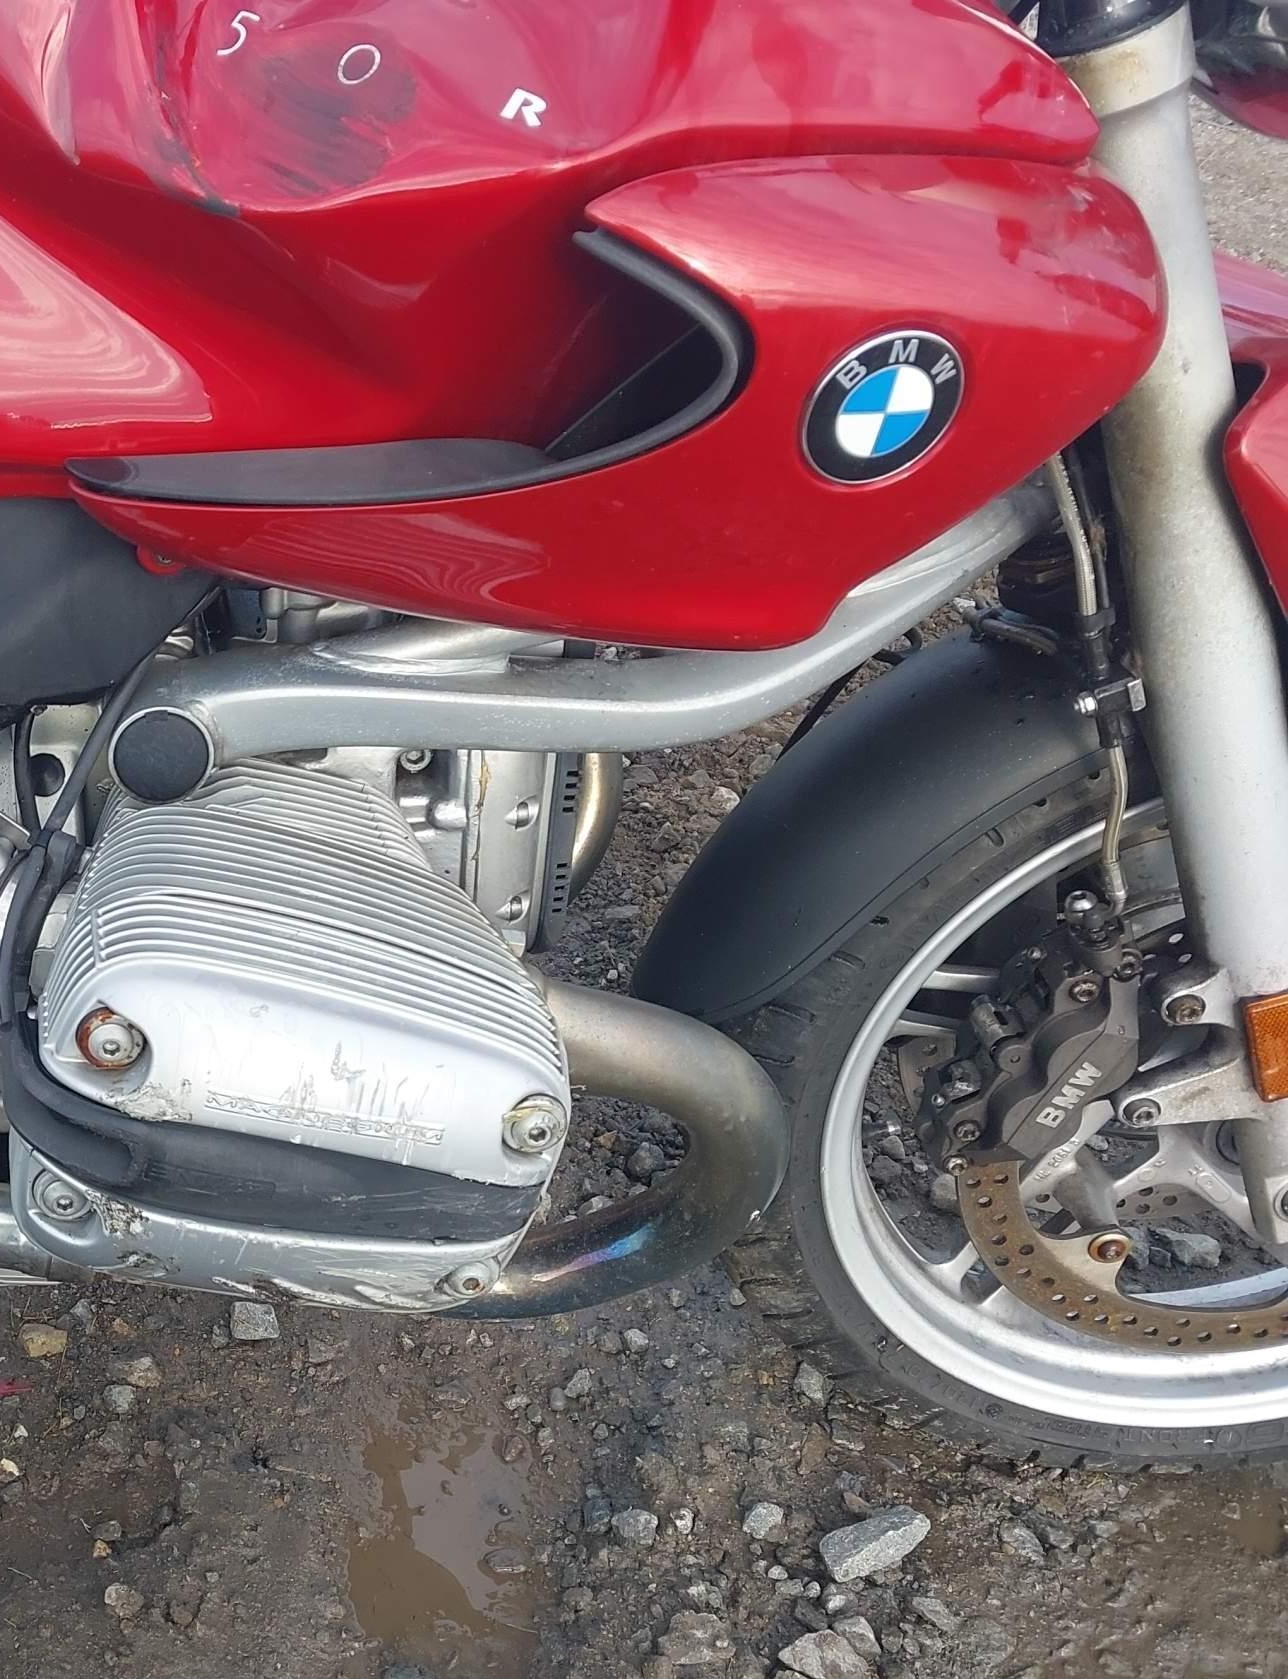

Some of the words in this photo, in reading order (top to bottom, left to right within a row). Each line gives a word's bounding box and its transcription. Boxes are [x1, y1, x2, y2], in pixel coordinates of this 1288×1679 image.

[215, 9, 261, 56] 5
[499, 87, 548, 127] R
[835, 338, 958, 390] BMW
[1036, 1061, 1103, 1129] BMW
